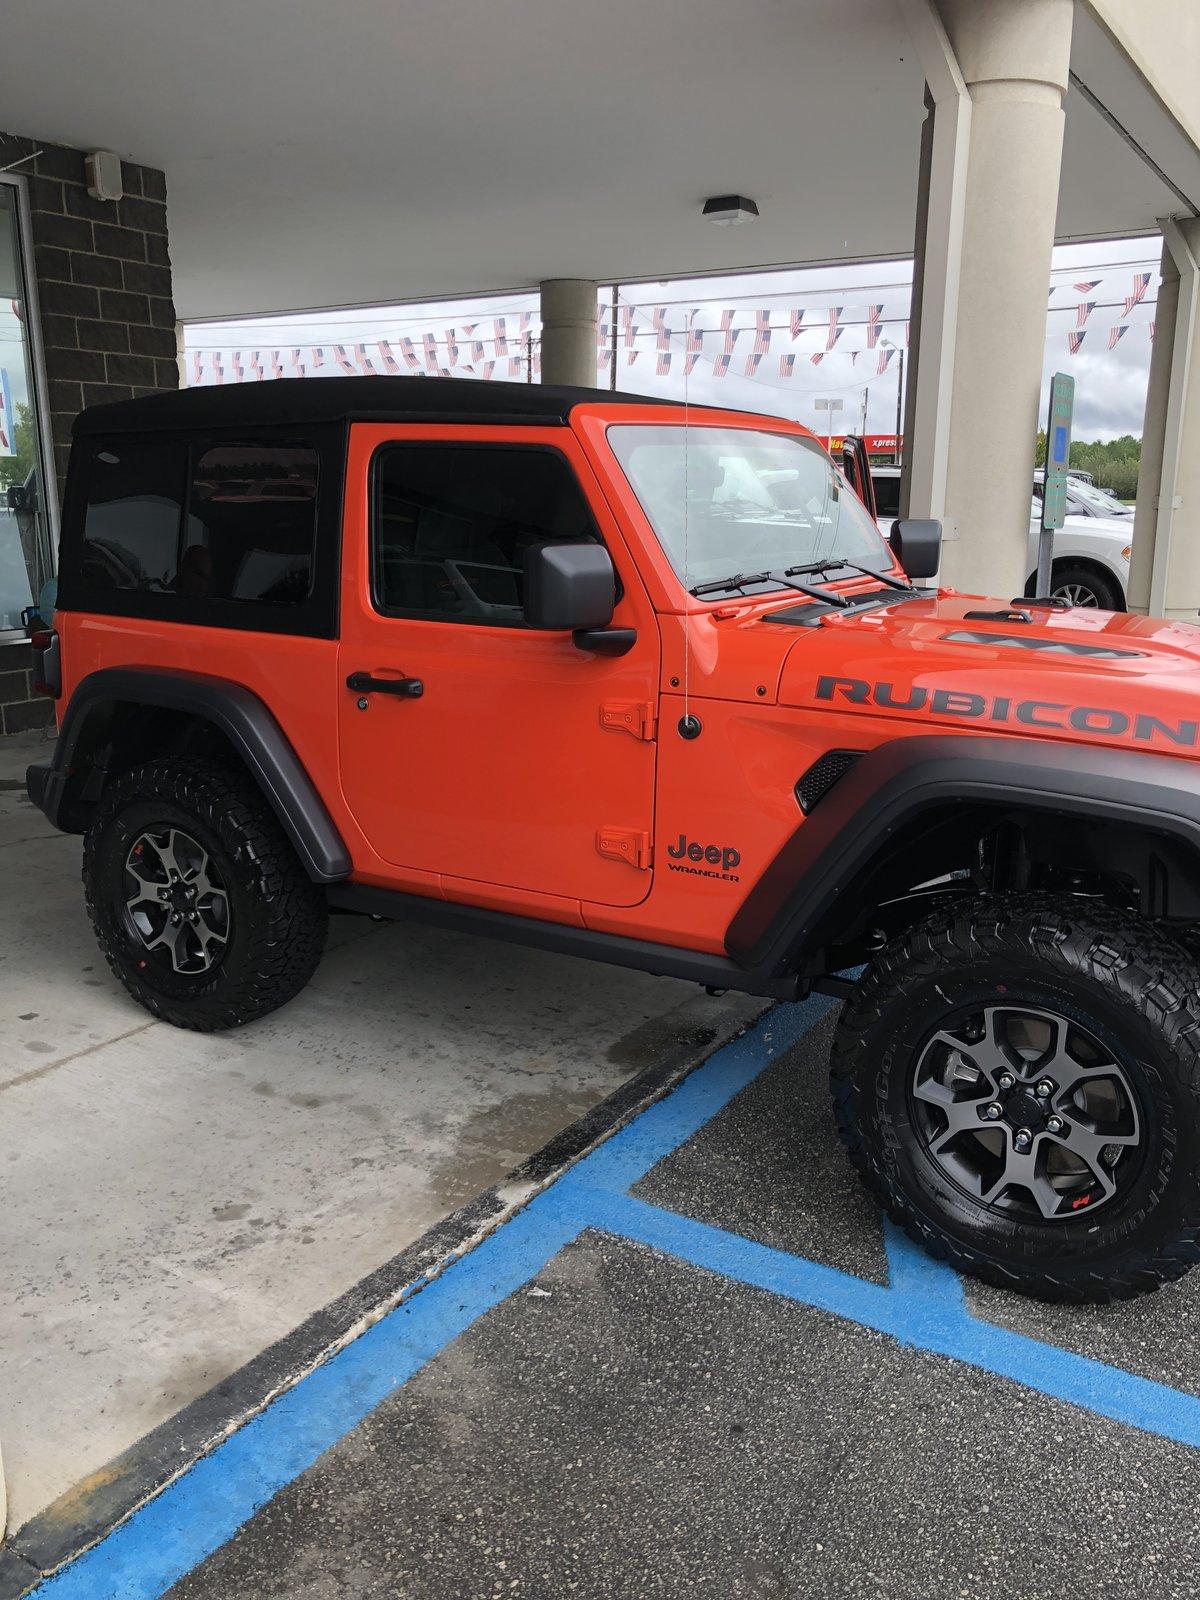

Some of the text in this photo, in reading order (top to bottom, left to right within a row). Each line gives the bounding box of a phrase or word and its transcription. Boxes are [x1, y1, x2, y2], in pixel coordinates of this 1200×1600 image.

[815, 675, 1199, 746] RUBICON
[667, 834, 741, 870] Jeep
[667, 863, 740, 882] WRANGLER
